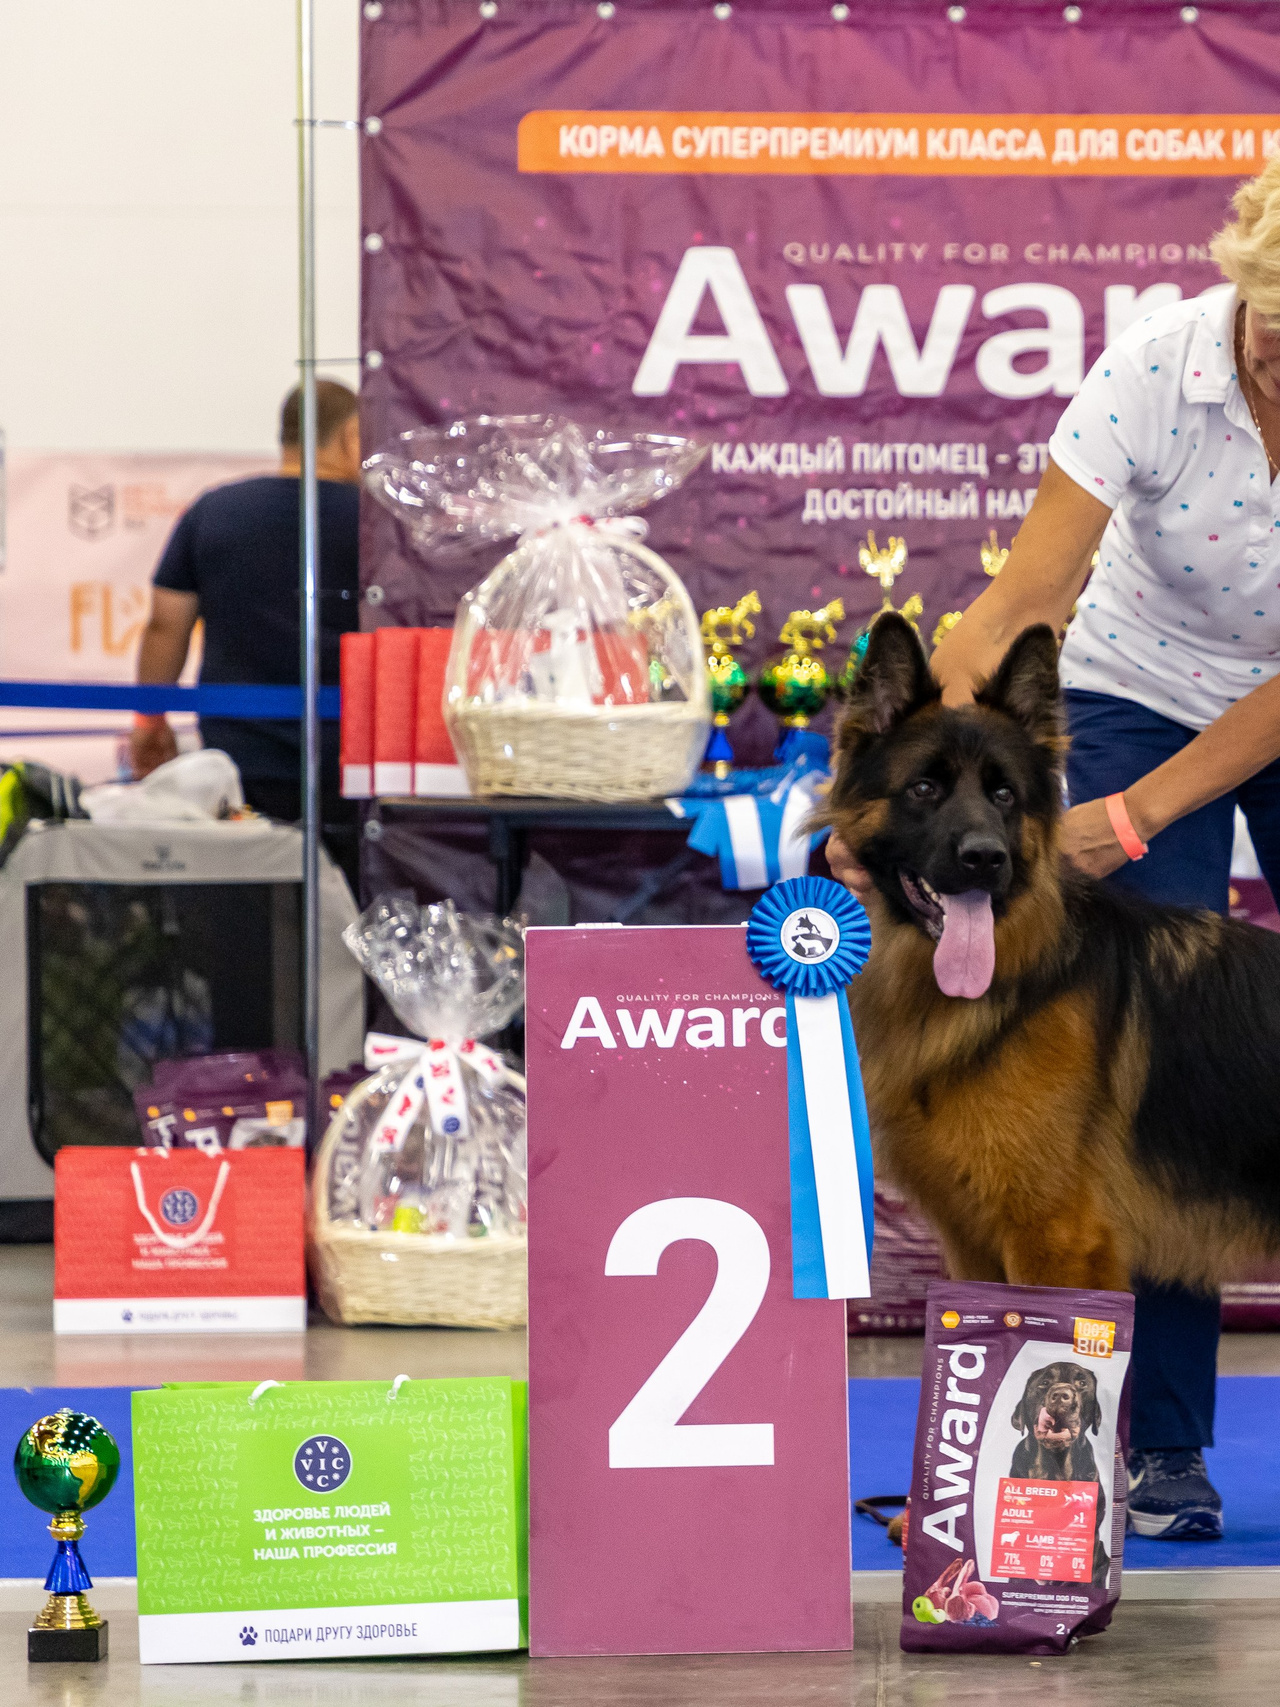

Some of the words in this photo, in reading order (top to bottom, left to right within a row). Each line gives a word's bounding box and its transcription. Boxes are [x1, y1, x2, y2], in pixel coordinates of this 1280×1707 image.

[559, 125, 665, 159] КОРМА
[672, 125, 919, 160] СУПЕРПРЕМИУМ
[927, 127, 1046, 160] КЛАССА
[1052, 128, 1119, 165] ДЛЯ
[1126, 128, 1226, 161] СОБАК
[1232, 128, 1255, 161] И
[783, 242, 927, 264] QUALITY
[944, 242, 1010, 264] FOR
[1024, 243, 1213, 265] CHAMPION
[631, 246, 1237, 399] Awar
[712, 437, 845, 478] КАЖДЫЙ
[852, 442, 989, 478] ПИТОМЕЦ
[1017, 443, 1050, 474] ЭТ
[802, 482, 979, 524] ДОСТОЙНЫЙ
[616, 994, 669, 1002] QUALITY
[705, 993, 779, 1001] CHAMPIONS
[604, 1196, 775, 1469] 2
[1077, 1322, 1110, 1338] 100%
[1077, 1338, 1109, 1356] BIO
[930, 1358, 944, 1422] CHAMPIONS
[922, 1344, 987, 1552] Award
[926, 1427, 936, 1449] FOR
[923, 1453, 932, 1500] QUALITY
[1004, 1486, 1023, 1495] ALL
[1025, 1487, 1058, 1496] BREED
[253, 1505, 330, 1524] ЗДОРОВЬЕ
[333, 1502, 391, 1520] ЛЮДЕЙ
[1002, 1508, 1034, 1518] ADULT
[265, 1529, 277, 1541] И
[281, 1526, 370, 1541] ЖИВОТНЫХ
[1026, 1534, 1054, 1544] LAMB
[253, 1547, 300, 1561] НАША
[304, 1542, 397, 1559] ПРОФЕССИЯ
[1004, 1553, 1020, 1565] 71%
[1040, 1555, 1054, 1568] 0%
[1072, 1557, 1085, 1570] 0%
[264, 1627, 313, 1645] ПОДАРИ
[316, 1625, 353, 1643] ДРУГУ
[356, 1622, 418, 1640] ЗДОРОВЬЕ
[1056, 1623, 1065, 1635] 2
